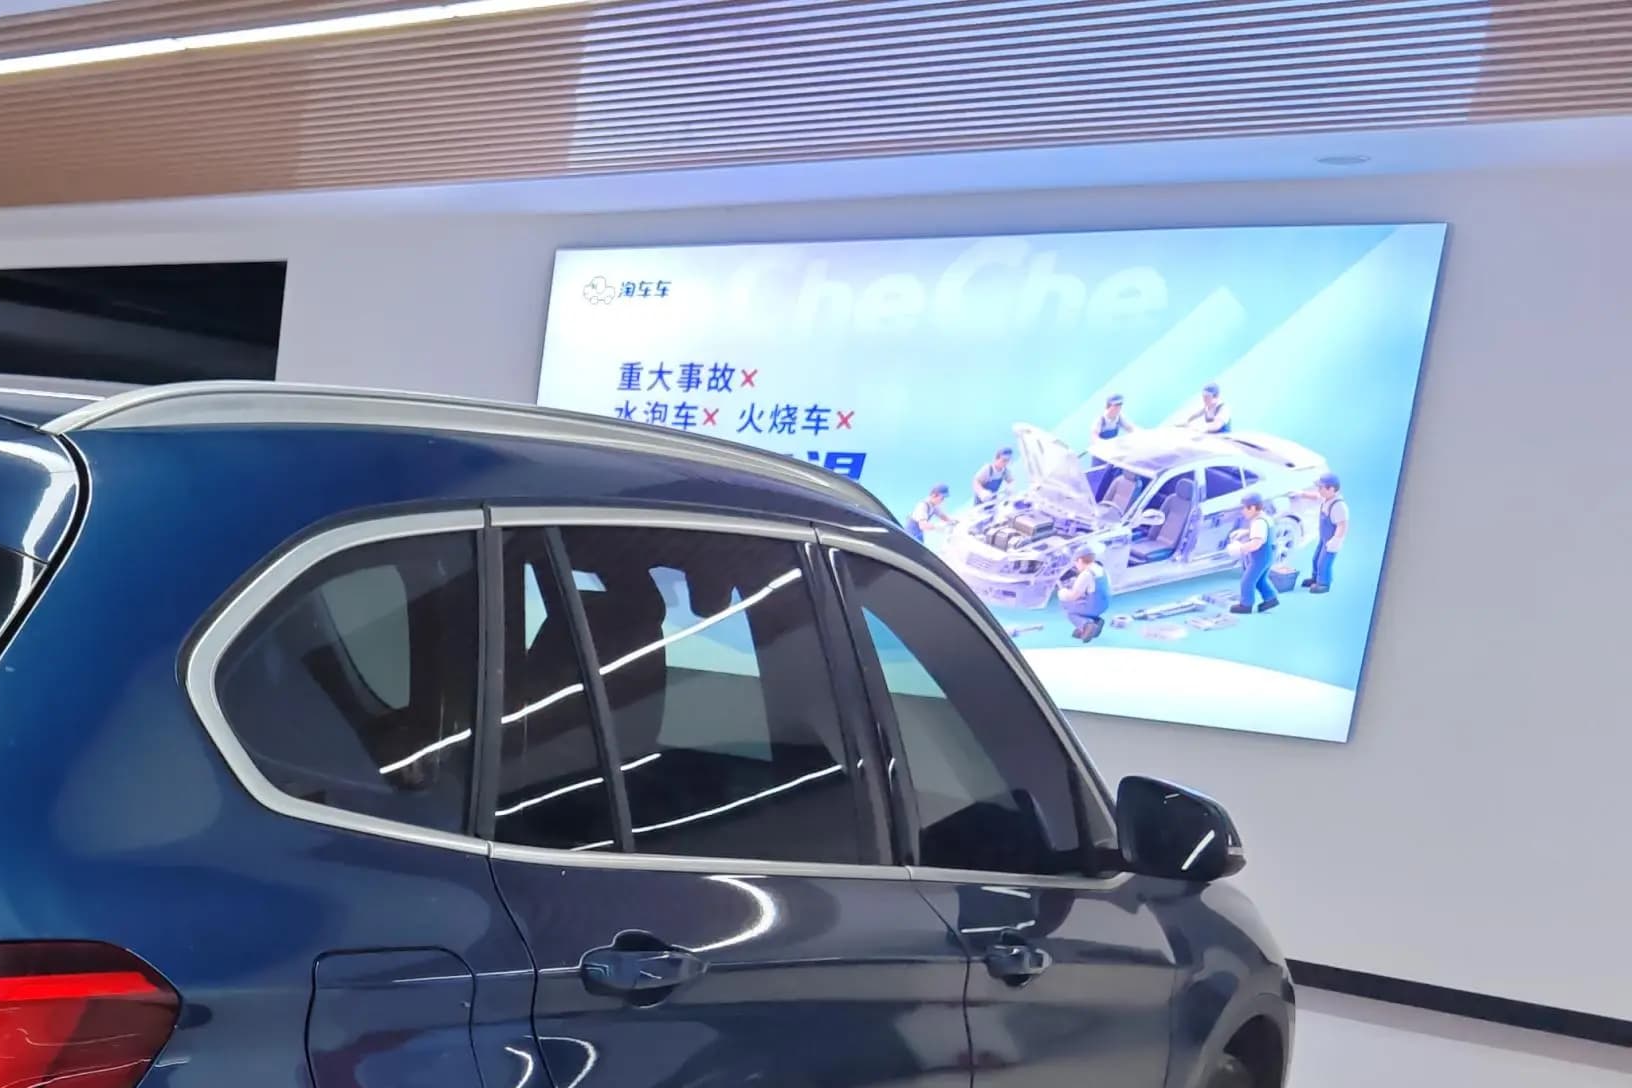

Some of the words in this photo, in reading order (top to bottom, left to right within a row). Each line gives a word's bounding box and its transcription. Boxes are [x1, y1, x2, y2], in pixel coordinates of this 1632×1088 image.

[618, 279, 672, 299] 淘车车
[617, 361, 736, 393] 重大事故
[736, 402, 831, 436] 火烧车
